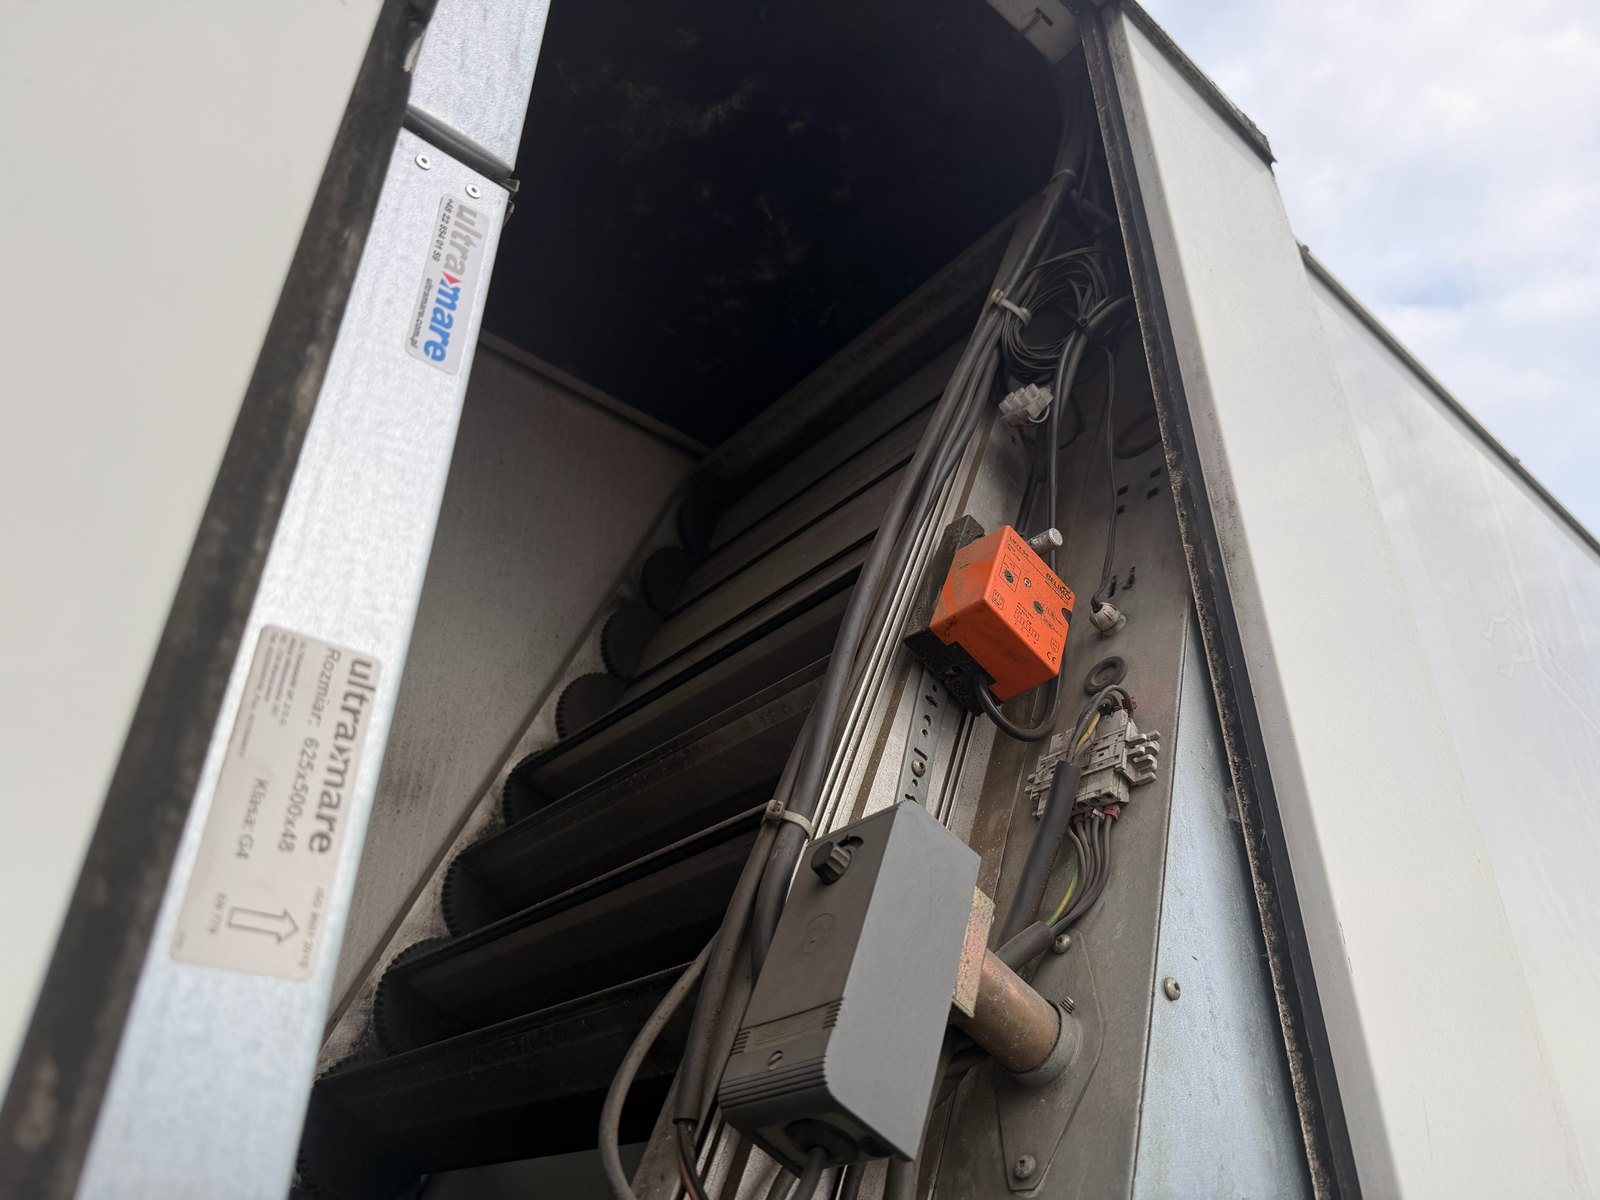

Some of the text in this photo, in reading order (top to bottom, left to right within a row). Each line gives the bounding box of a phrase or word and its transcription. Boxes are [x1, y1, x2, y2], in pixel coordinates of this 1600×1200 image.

[440, 213, 451, 224] 22
[443, 198, 454, 213] +48
[410, 277, 433, 349] ultramare.com.pl
[424, 204, 482, 362] ultramare
[1046, 572, 1072, 601] BELIMO
[307, 647, 342, 727] Rozmiar:
[308, 657, 377, 855] ultramare
[242, 777, 270, 831] Klasa:
[278, 737, 320, 854] 625x500x48
[235, 834, 255, 860] G4
